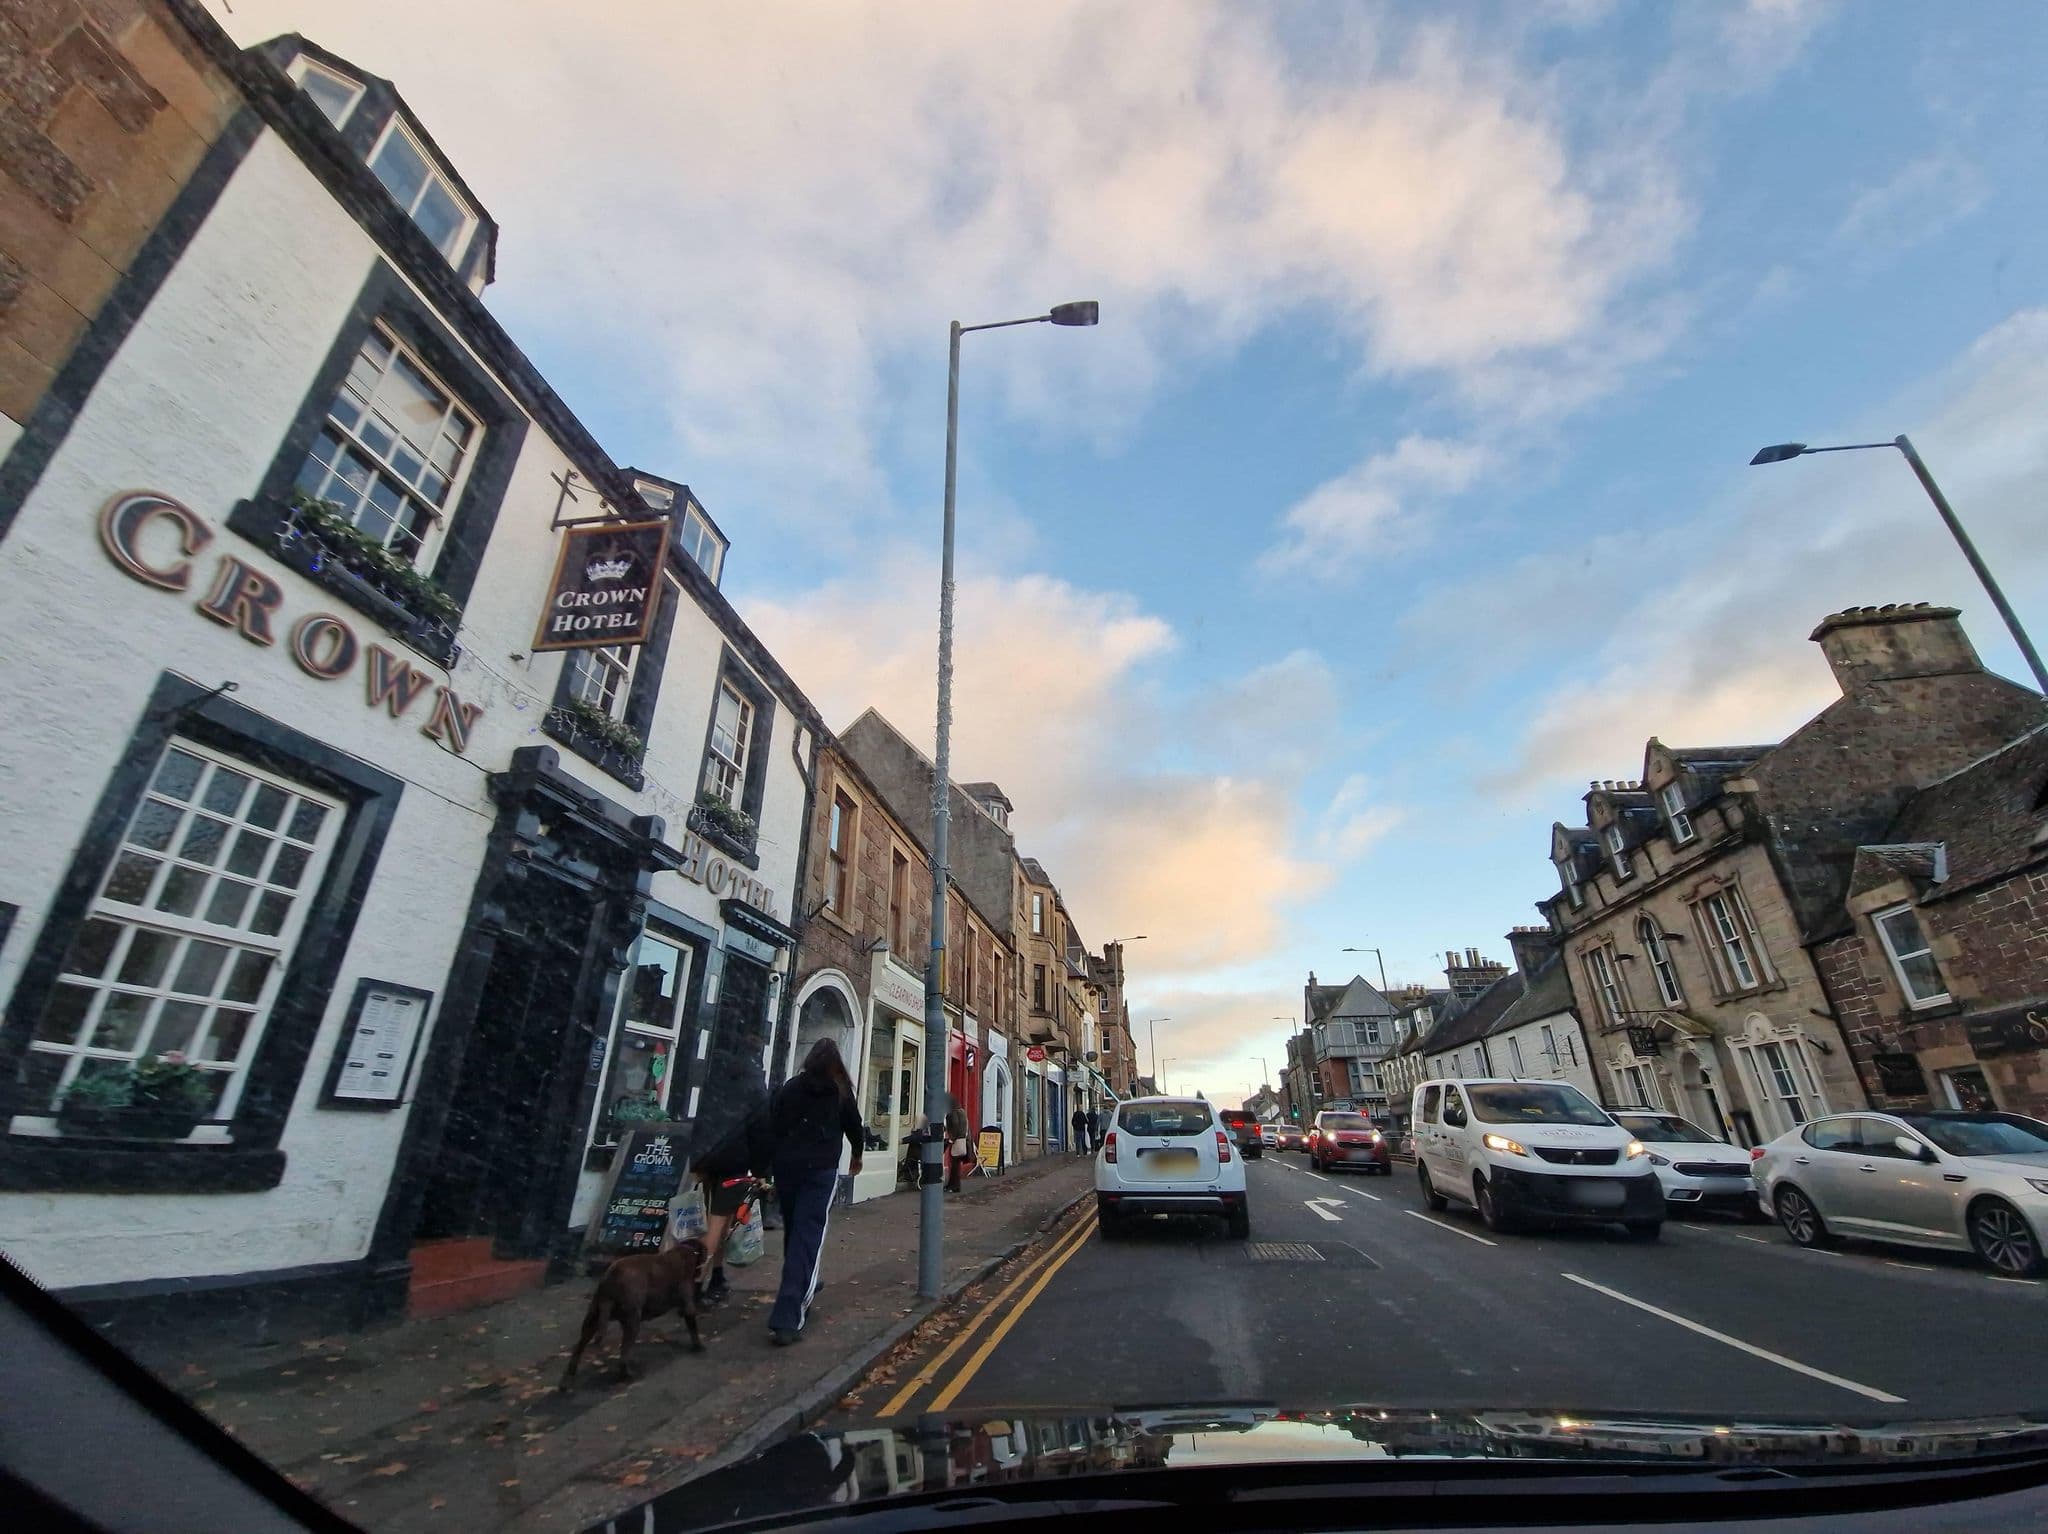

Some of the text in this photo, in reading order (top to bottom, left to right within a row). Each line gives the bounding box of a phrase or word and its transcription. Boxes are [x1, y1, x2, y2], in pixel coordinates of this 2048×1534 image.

[557, 587, 648, 608] CROWN
[98, 487, 485, 753] CROWN
[551, 612, 638, 632] HOTEL
[677, 830, 778, 920] HOTEL
[633, 1153, 674, 1166] CROWN
[645, 1144, 672, 1155] THE
